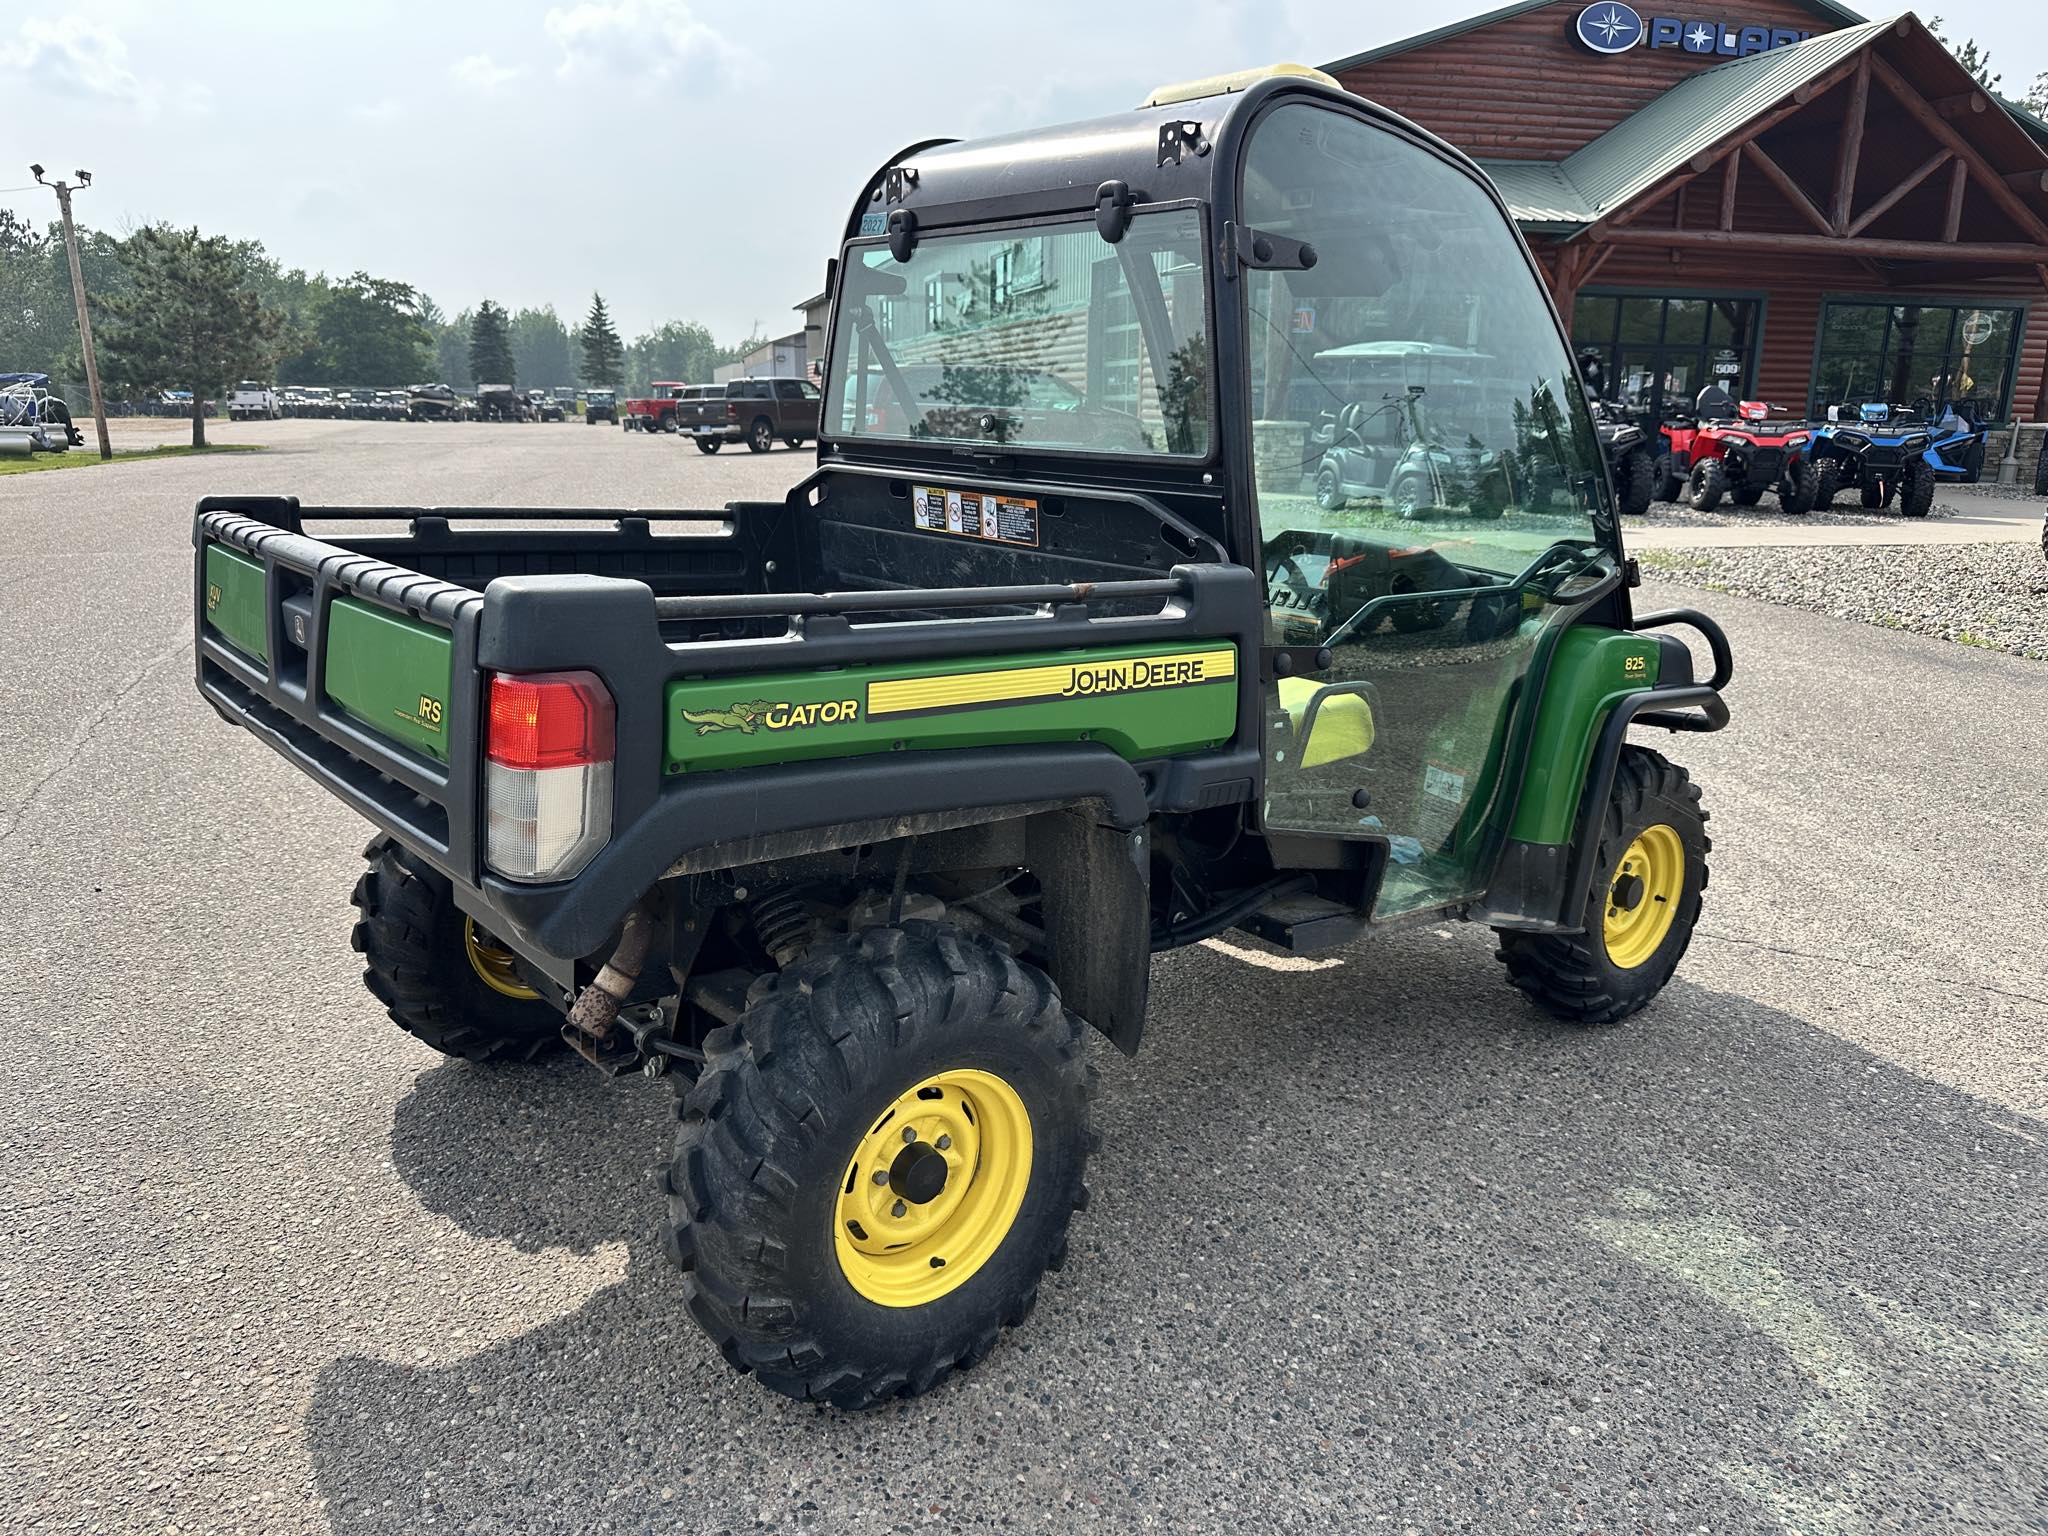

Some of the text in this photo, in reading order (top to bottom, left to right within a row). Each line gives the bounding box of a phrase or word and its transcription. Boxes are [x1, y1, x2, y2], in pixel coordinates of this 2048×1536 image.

[1651, 17, 1809, 57] POLAR
[863, 219, 883, 232] 2027
[1063, 660, 1204, 693] JOHN DEERE
[418, 695, 442, 723] IRS
[765, 700, 858, 729] GATOR
